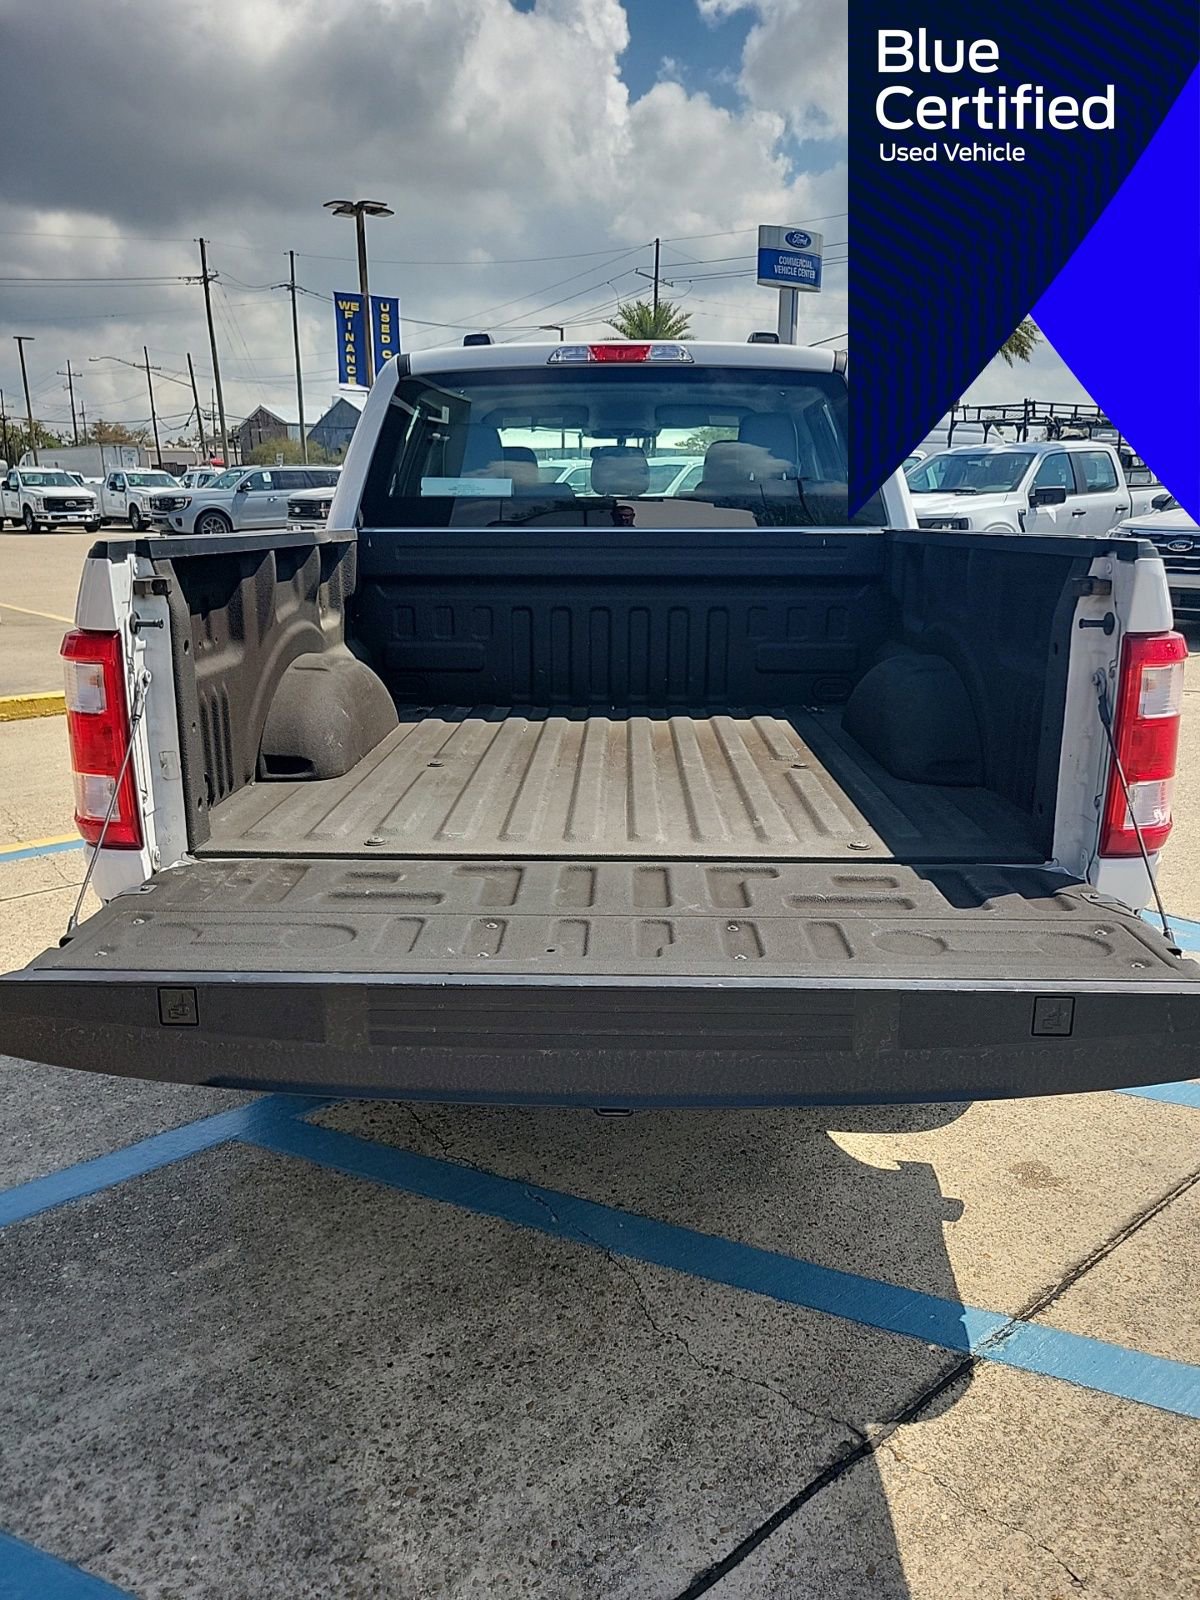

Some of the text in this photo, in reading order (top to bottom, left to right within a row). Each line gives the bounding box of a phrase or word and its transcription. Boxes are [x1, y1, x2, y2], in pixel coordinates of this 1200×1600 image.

[792, 233, 808, 245] Ford
[779, 256, 813, 269] COMMERCIAL
[774, 264, 815, 279] VEHICLE CENTER
[338, 301, 359, 312] WE
[380, 302, 391, 344] USED
[344, 311, 357, 385] FINANCE
